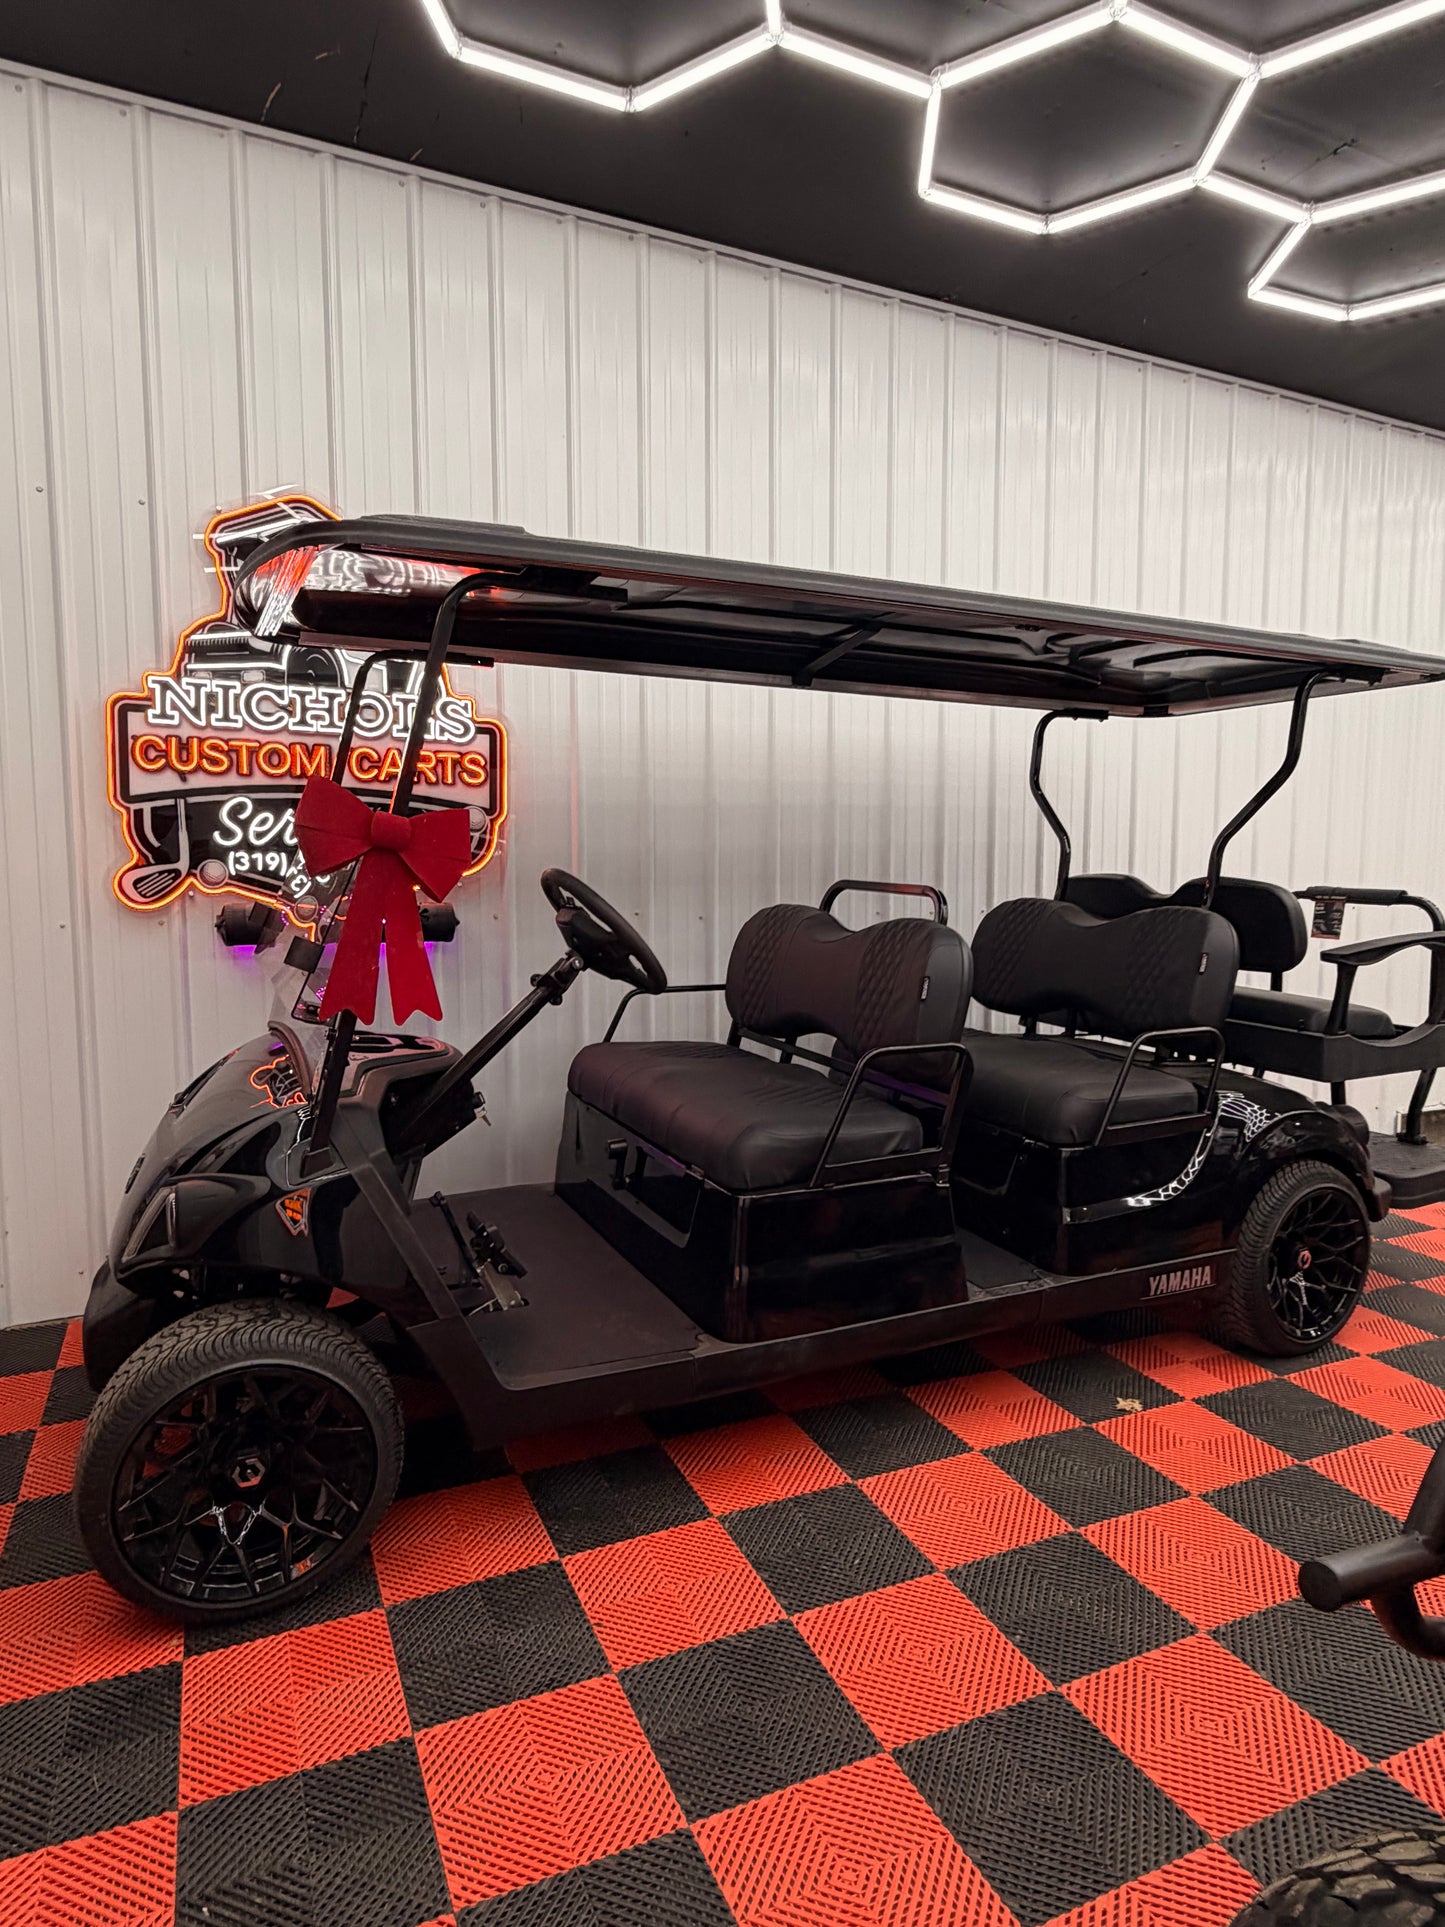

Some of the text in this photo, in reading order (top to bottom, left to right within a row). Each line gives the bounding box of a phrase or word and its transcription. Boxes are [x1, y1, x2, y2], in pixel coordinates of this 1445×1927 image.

[148, 676, 475, 743] NICHOLS
[132, 735, 488, 786] CUSTOM CARTS
[213, 796, 298, 846] Ser
[1149, 1265, 1211, 1296] YAMAHA
